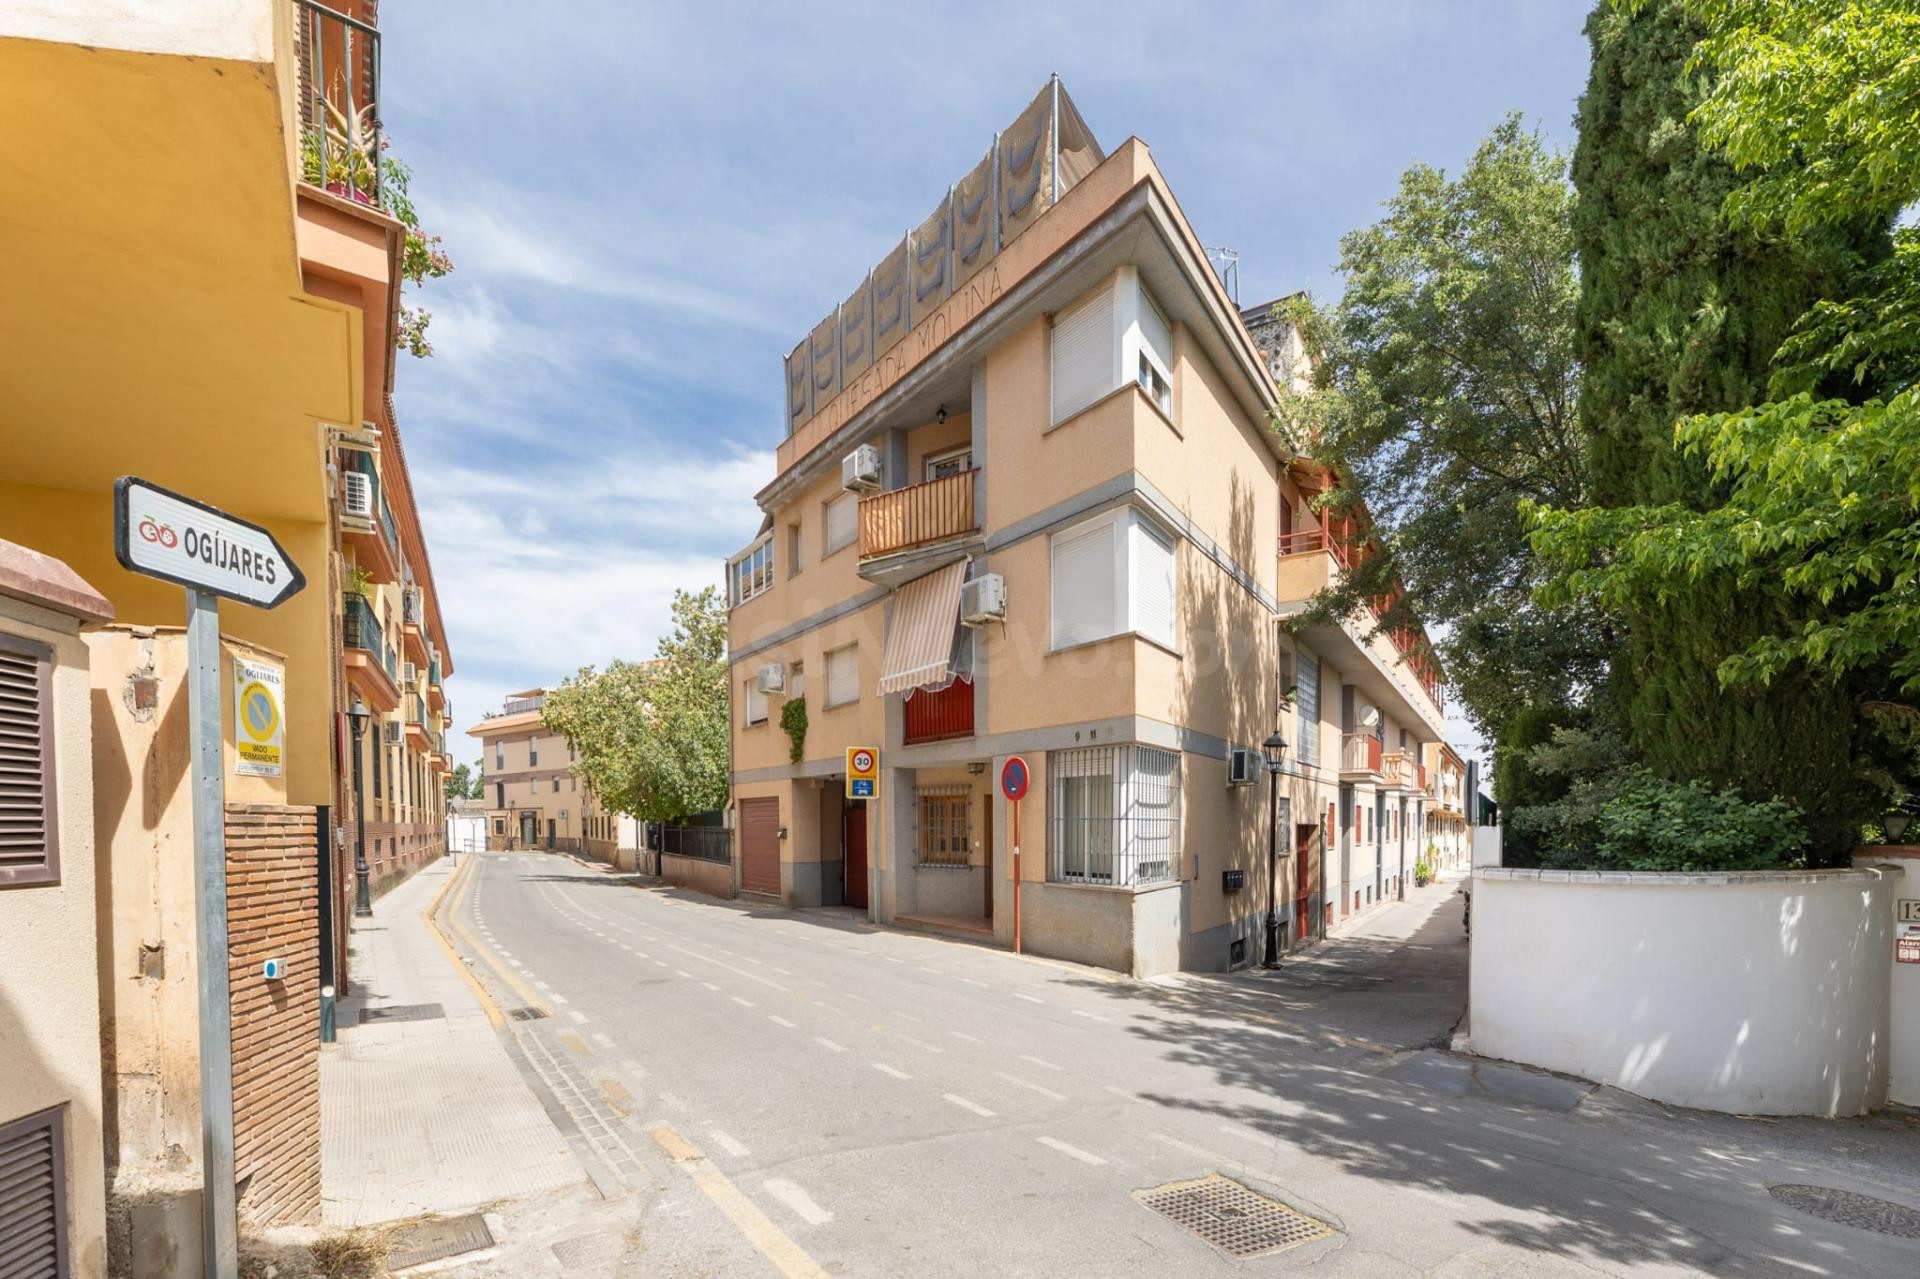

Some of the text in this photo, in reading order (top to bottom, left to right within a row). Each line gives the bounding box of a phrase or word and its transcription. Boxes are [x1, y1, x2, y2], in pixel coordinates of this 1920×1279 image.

[918, 266, 1002, 351] MOLINA
[184, 526, 276, 585] OGÍJARES
[252, 743, 268, 753] VADO
[240, 751, 280, 764] PERMANENTE
[856, 757, 870, 766] 30
